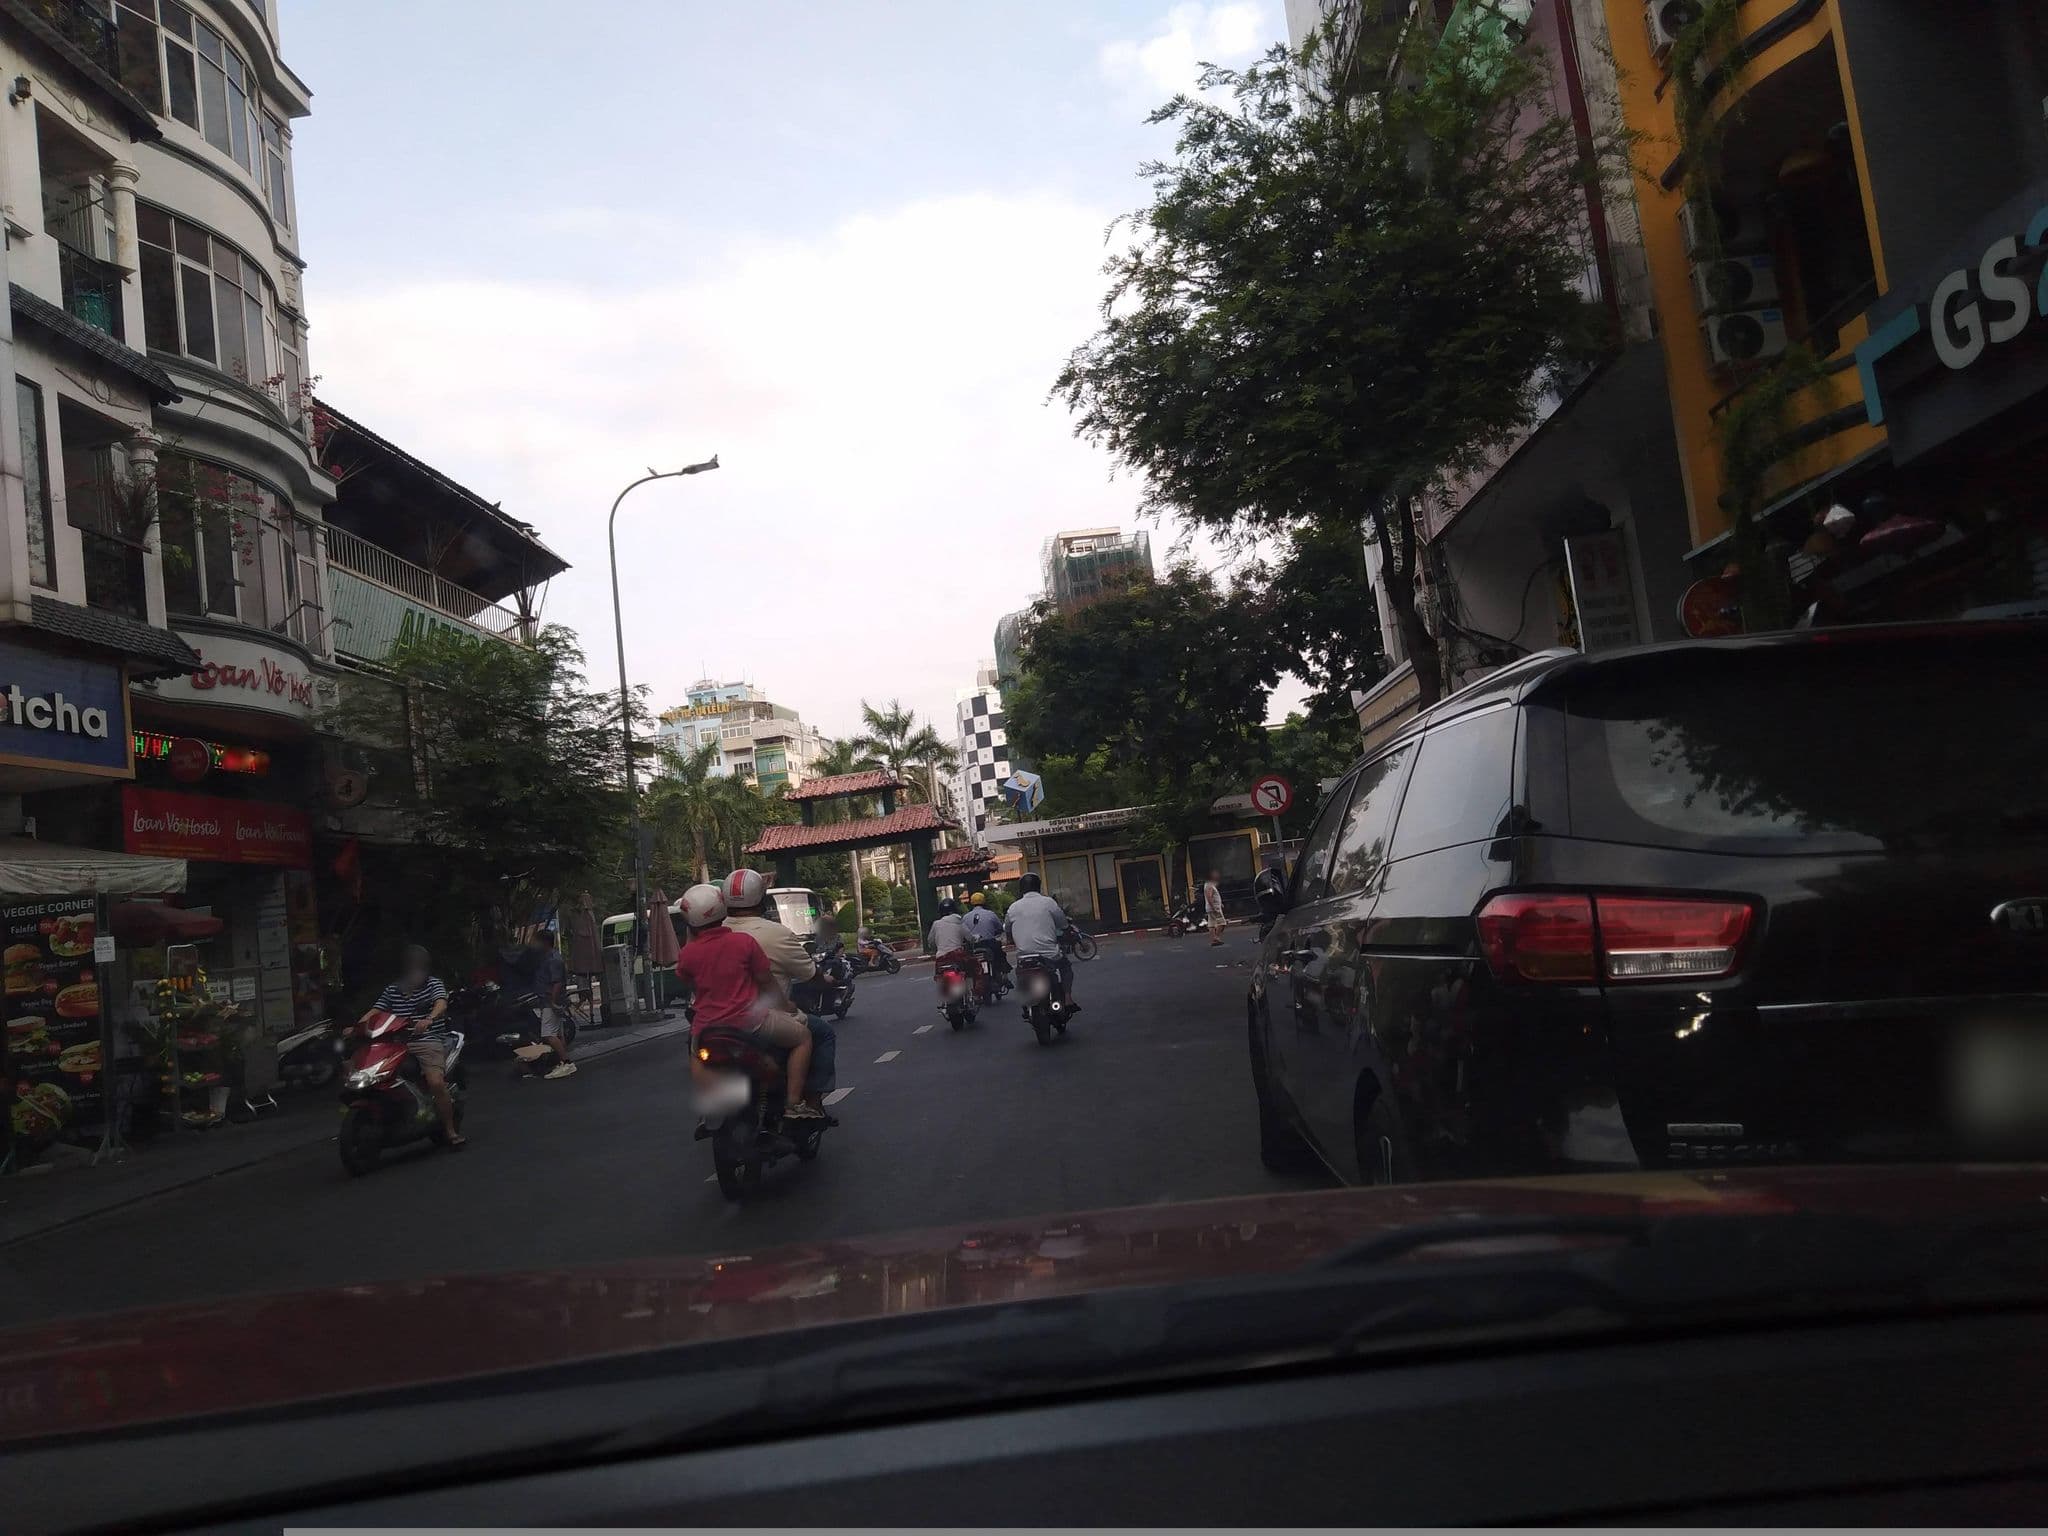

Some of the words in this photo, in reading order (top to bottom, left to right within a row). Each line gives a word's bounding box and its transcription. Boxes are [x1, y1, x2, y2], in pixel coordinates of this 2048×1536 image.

[0, 684, 108, 738] tcha
[132, 809, 164, 833] Loan
[185, 817, 221, 836] Hostel
[235, 819, 264, 841] Loan
[3, 904, 46, 919] VEGGIE
[47, 898, 94, 913] CORNER
